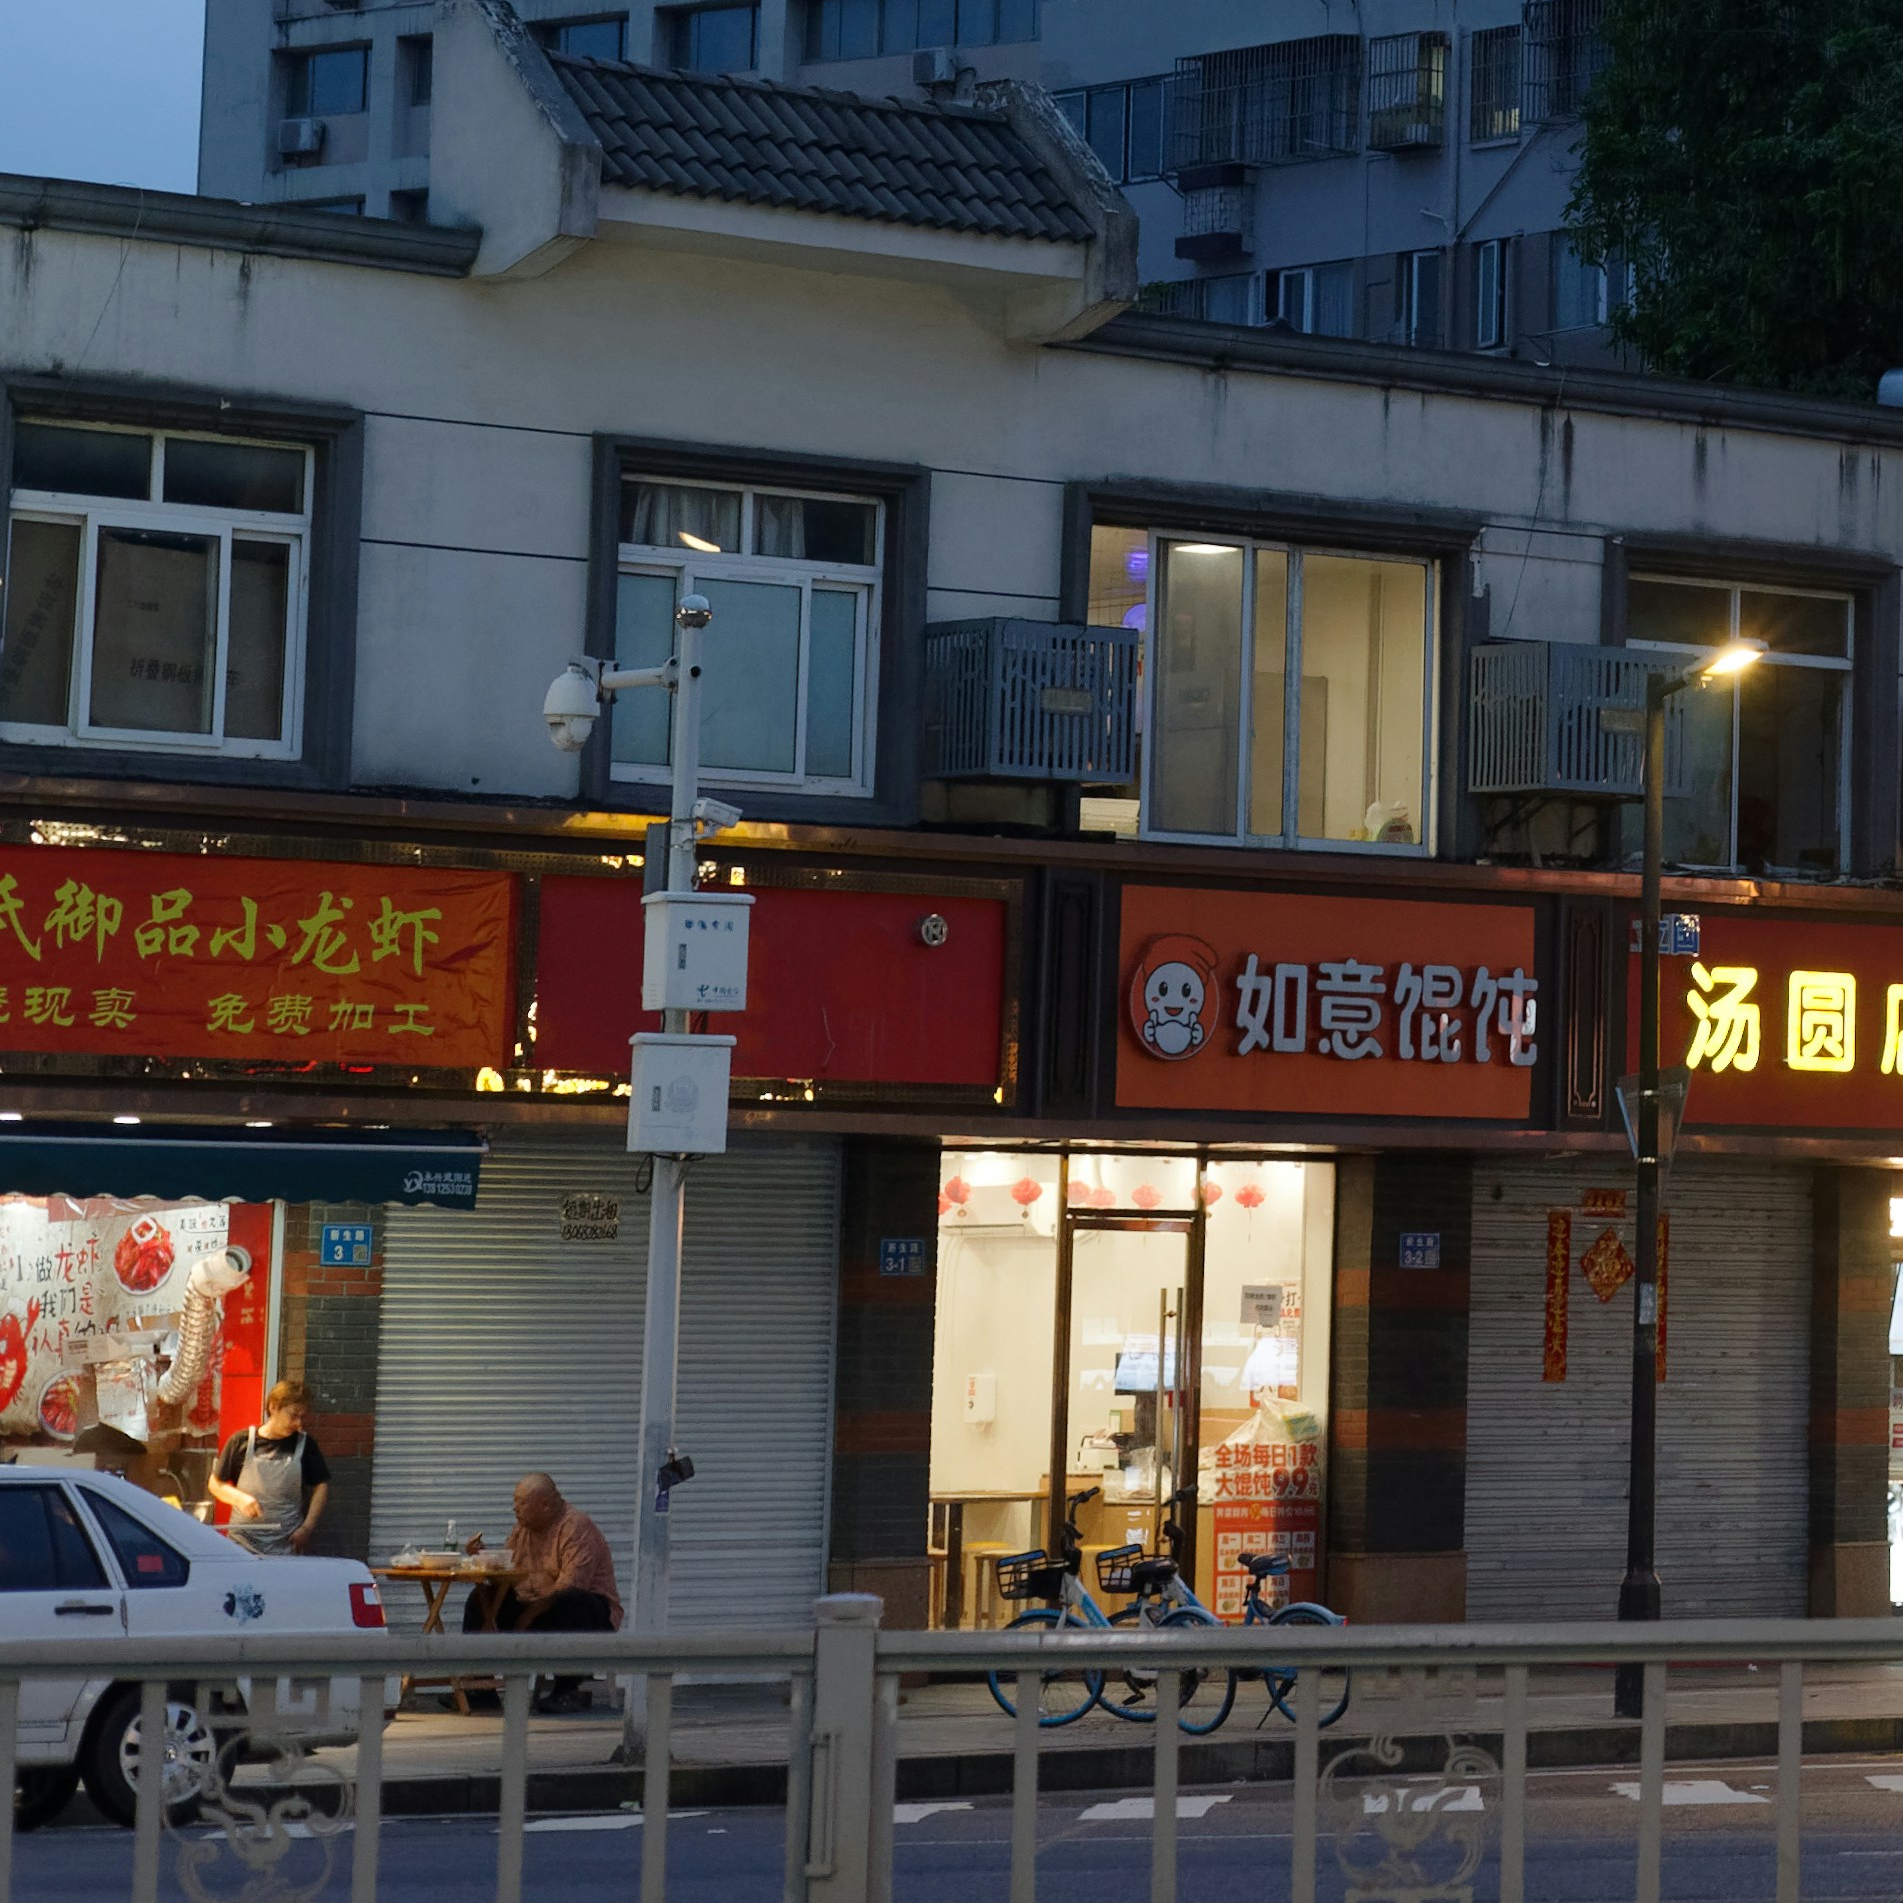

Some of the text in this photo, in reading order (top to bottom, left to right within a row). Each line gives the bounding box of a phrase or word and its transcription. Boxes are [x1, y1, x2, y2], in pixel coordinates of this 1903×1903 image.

[0, 986, 436, 1036] 现卖 免费加工
[1236, 952, 1539, 1067] 如意馄饨
[1215, 1443, 1318, 1468] 全场每日1款
